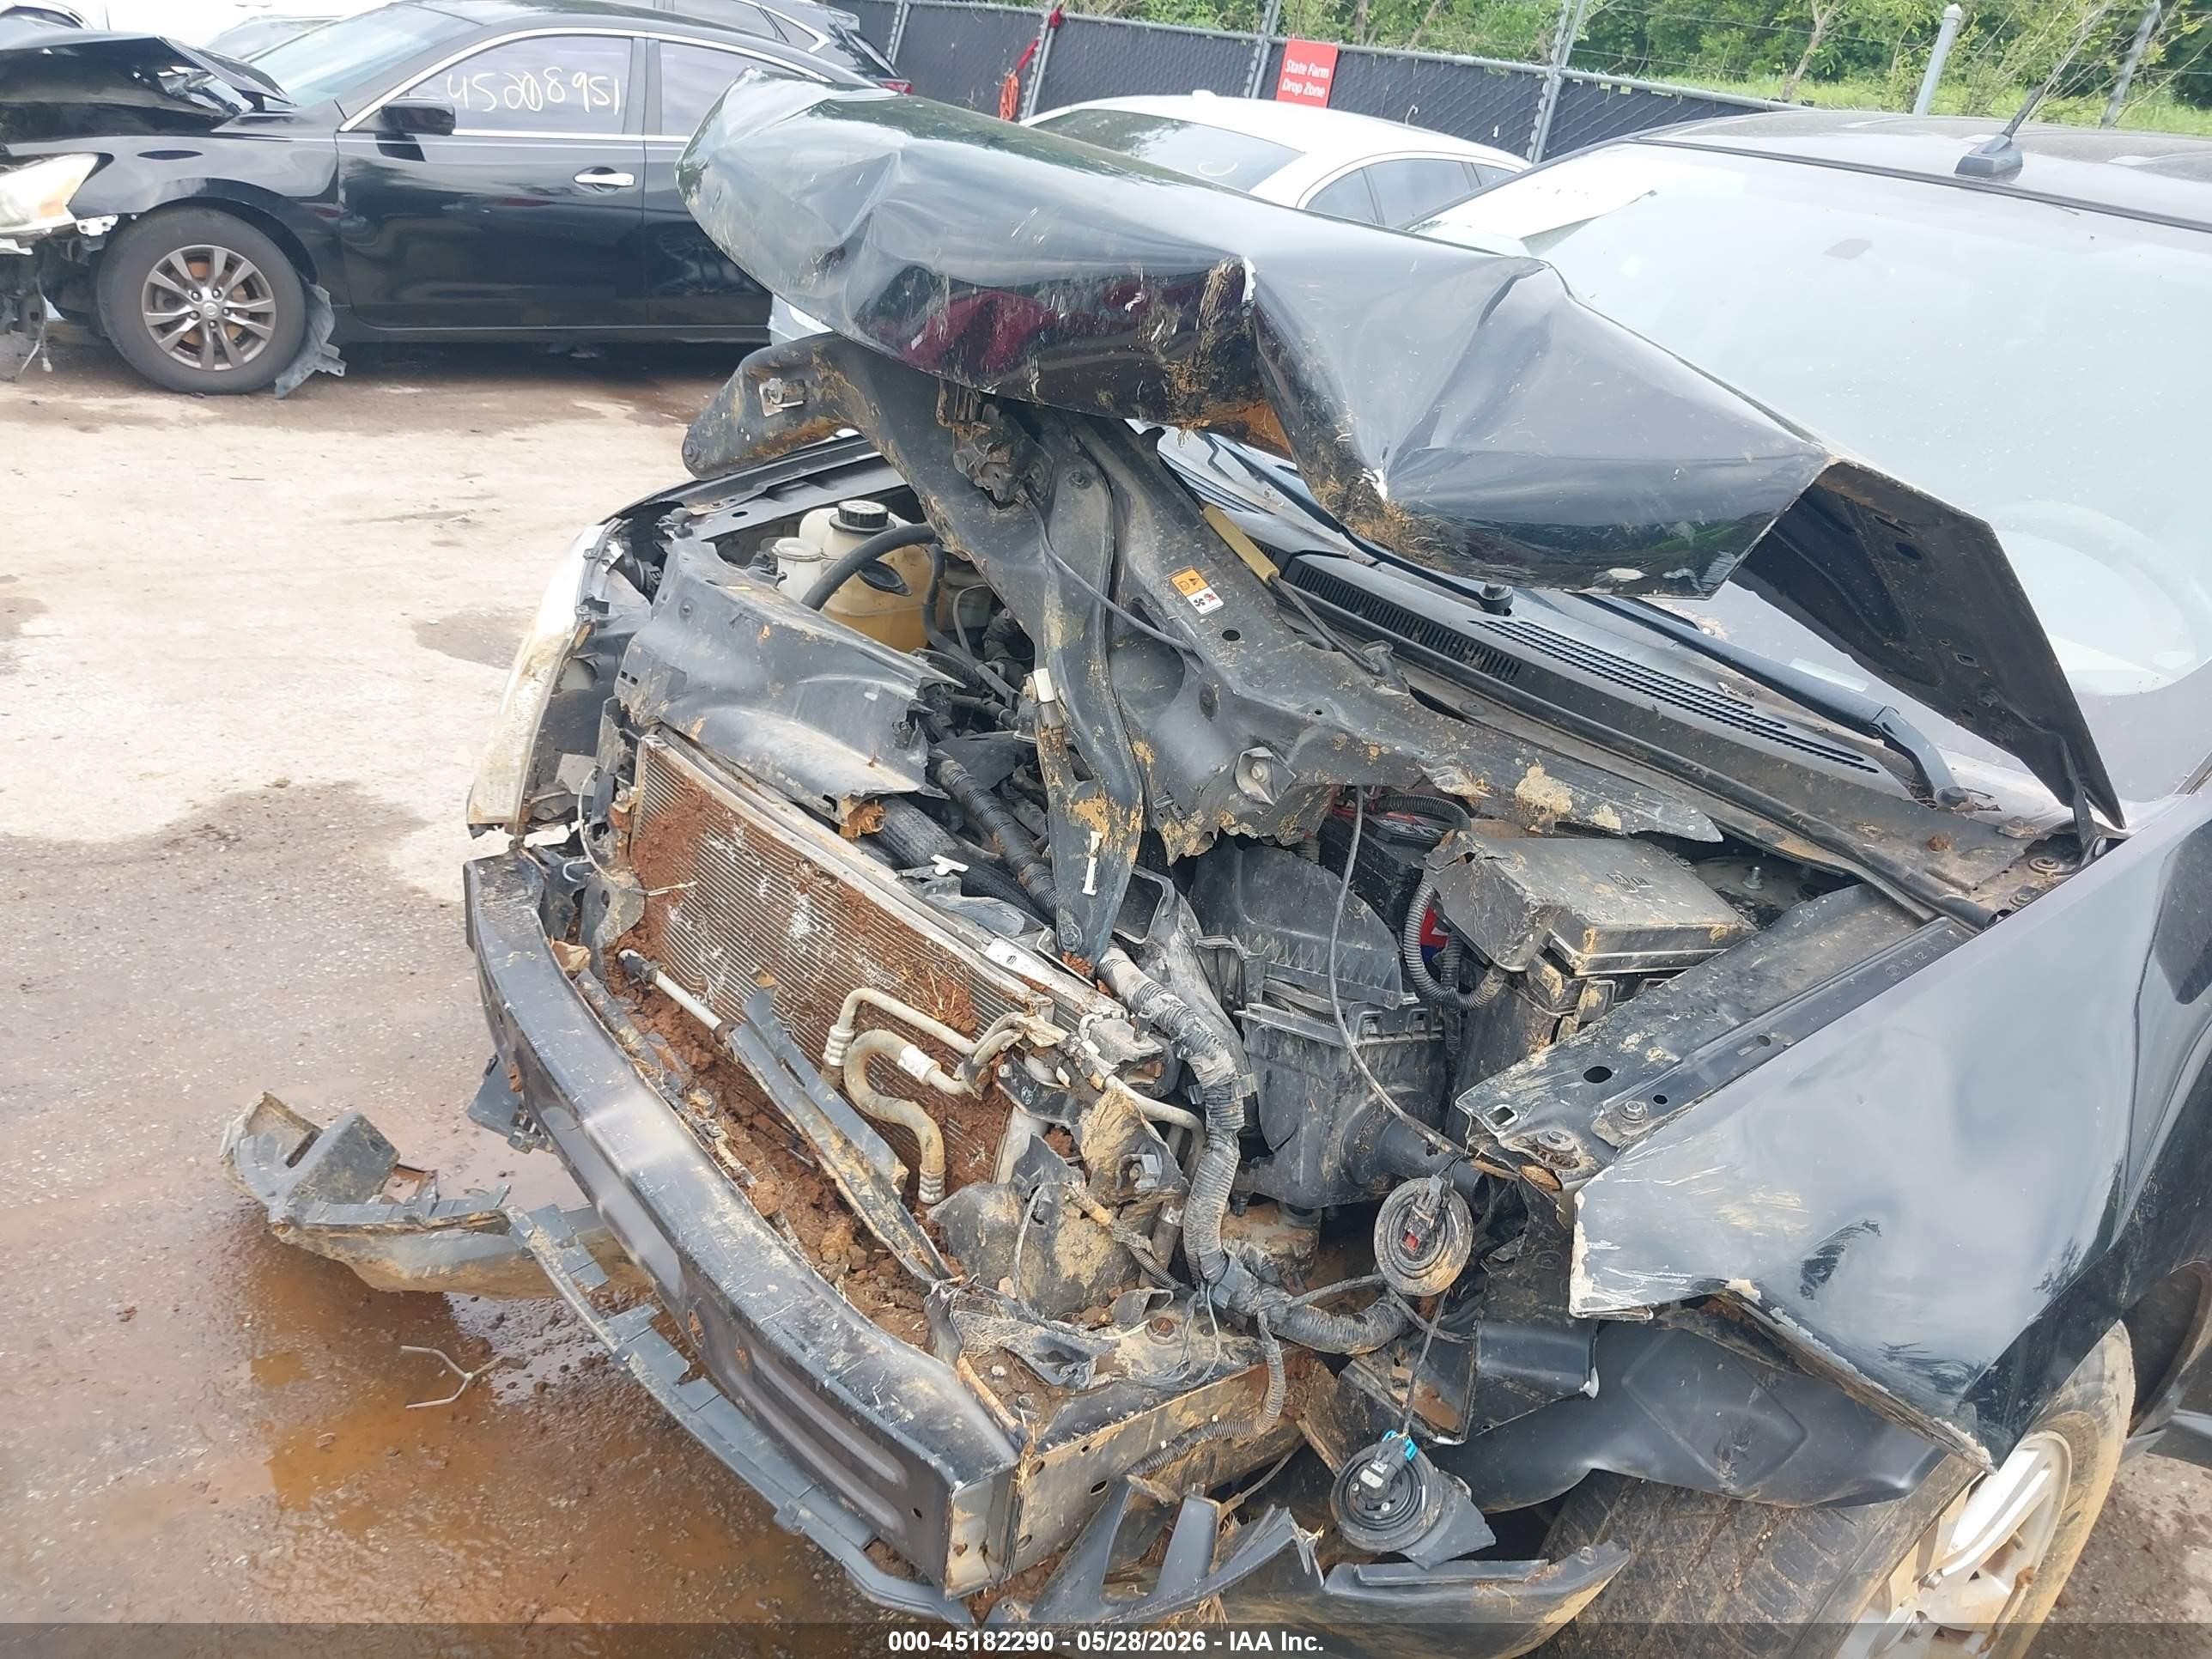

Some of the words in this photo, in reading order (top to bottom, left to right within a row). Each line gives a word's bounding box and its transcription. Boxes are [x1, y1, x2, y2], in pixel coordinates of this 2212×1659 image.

[1285, 59, 1306, 76] State
[1308, 62, 1329, 78] Farm
[1282, 78, 1303, 96] Drop
[1304, 82, 1326, 98] Zone
